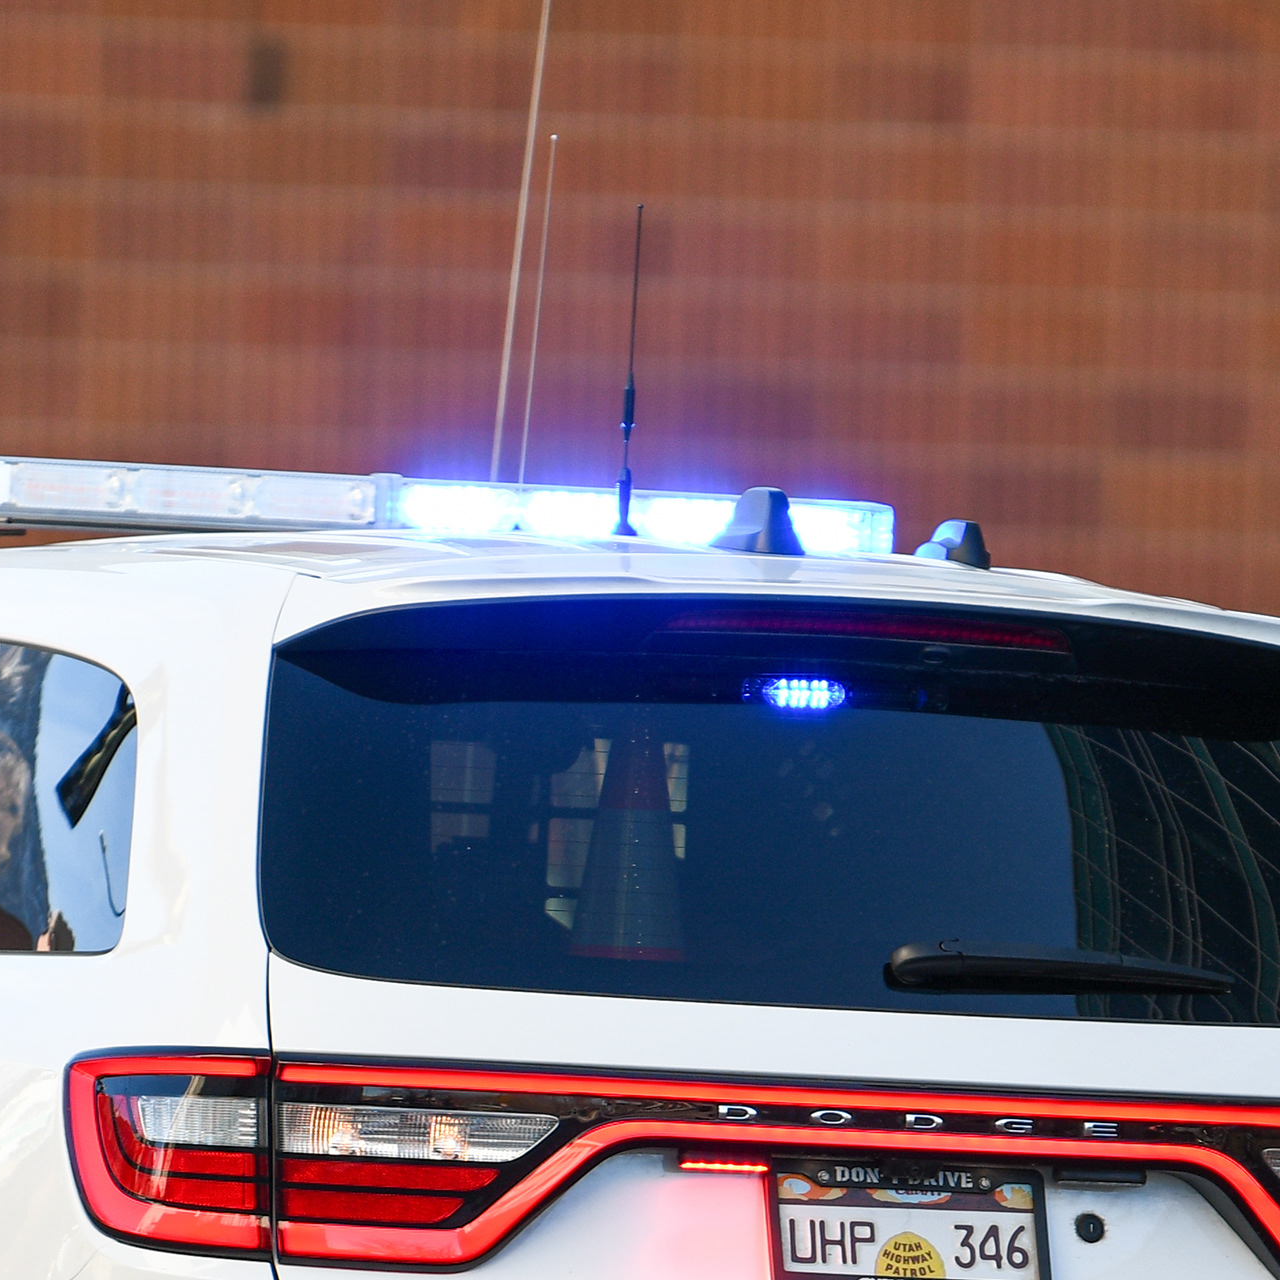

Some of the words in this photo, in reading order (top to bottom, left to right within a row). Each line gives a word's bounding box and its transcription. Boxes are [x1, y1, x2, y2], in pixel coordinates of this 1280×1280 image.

[717, 1103, 1120, 1138] DODGE
[789, 1218, 875, 1265] UHP
[954, 1223, 1030, 1270] 346
[893, 1241, 923, 1253] UTAH
[881, 1248, 935, 1265] HIGHWAY
[884, 1262, 936, 1278] PATROL
